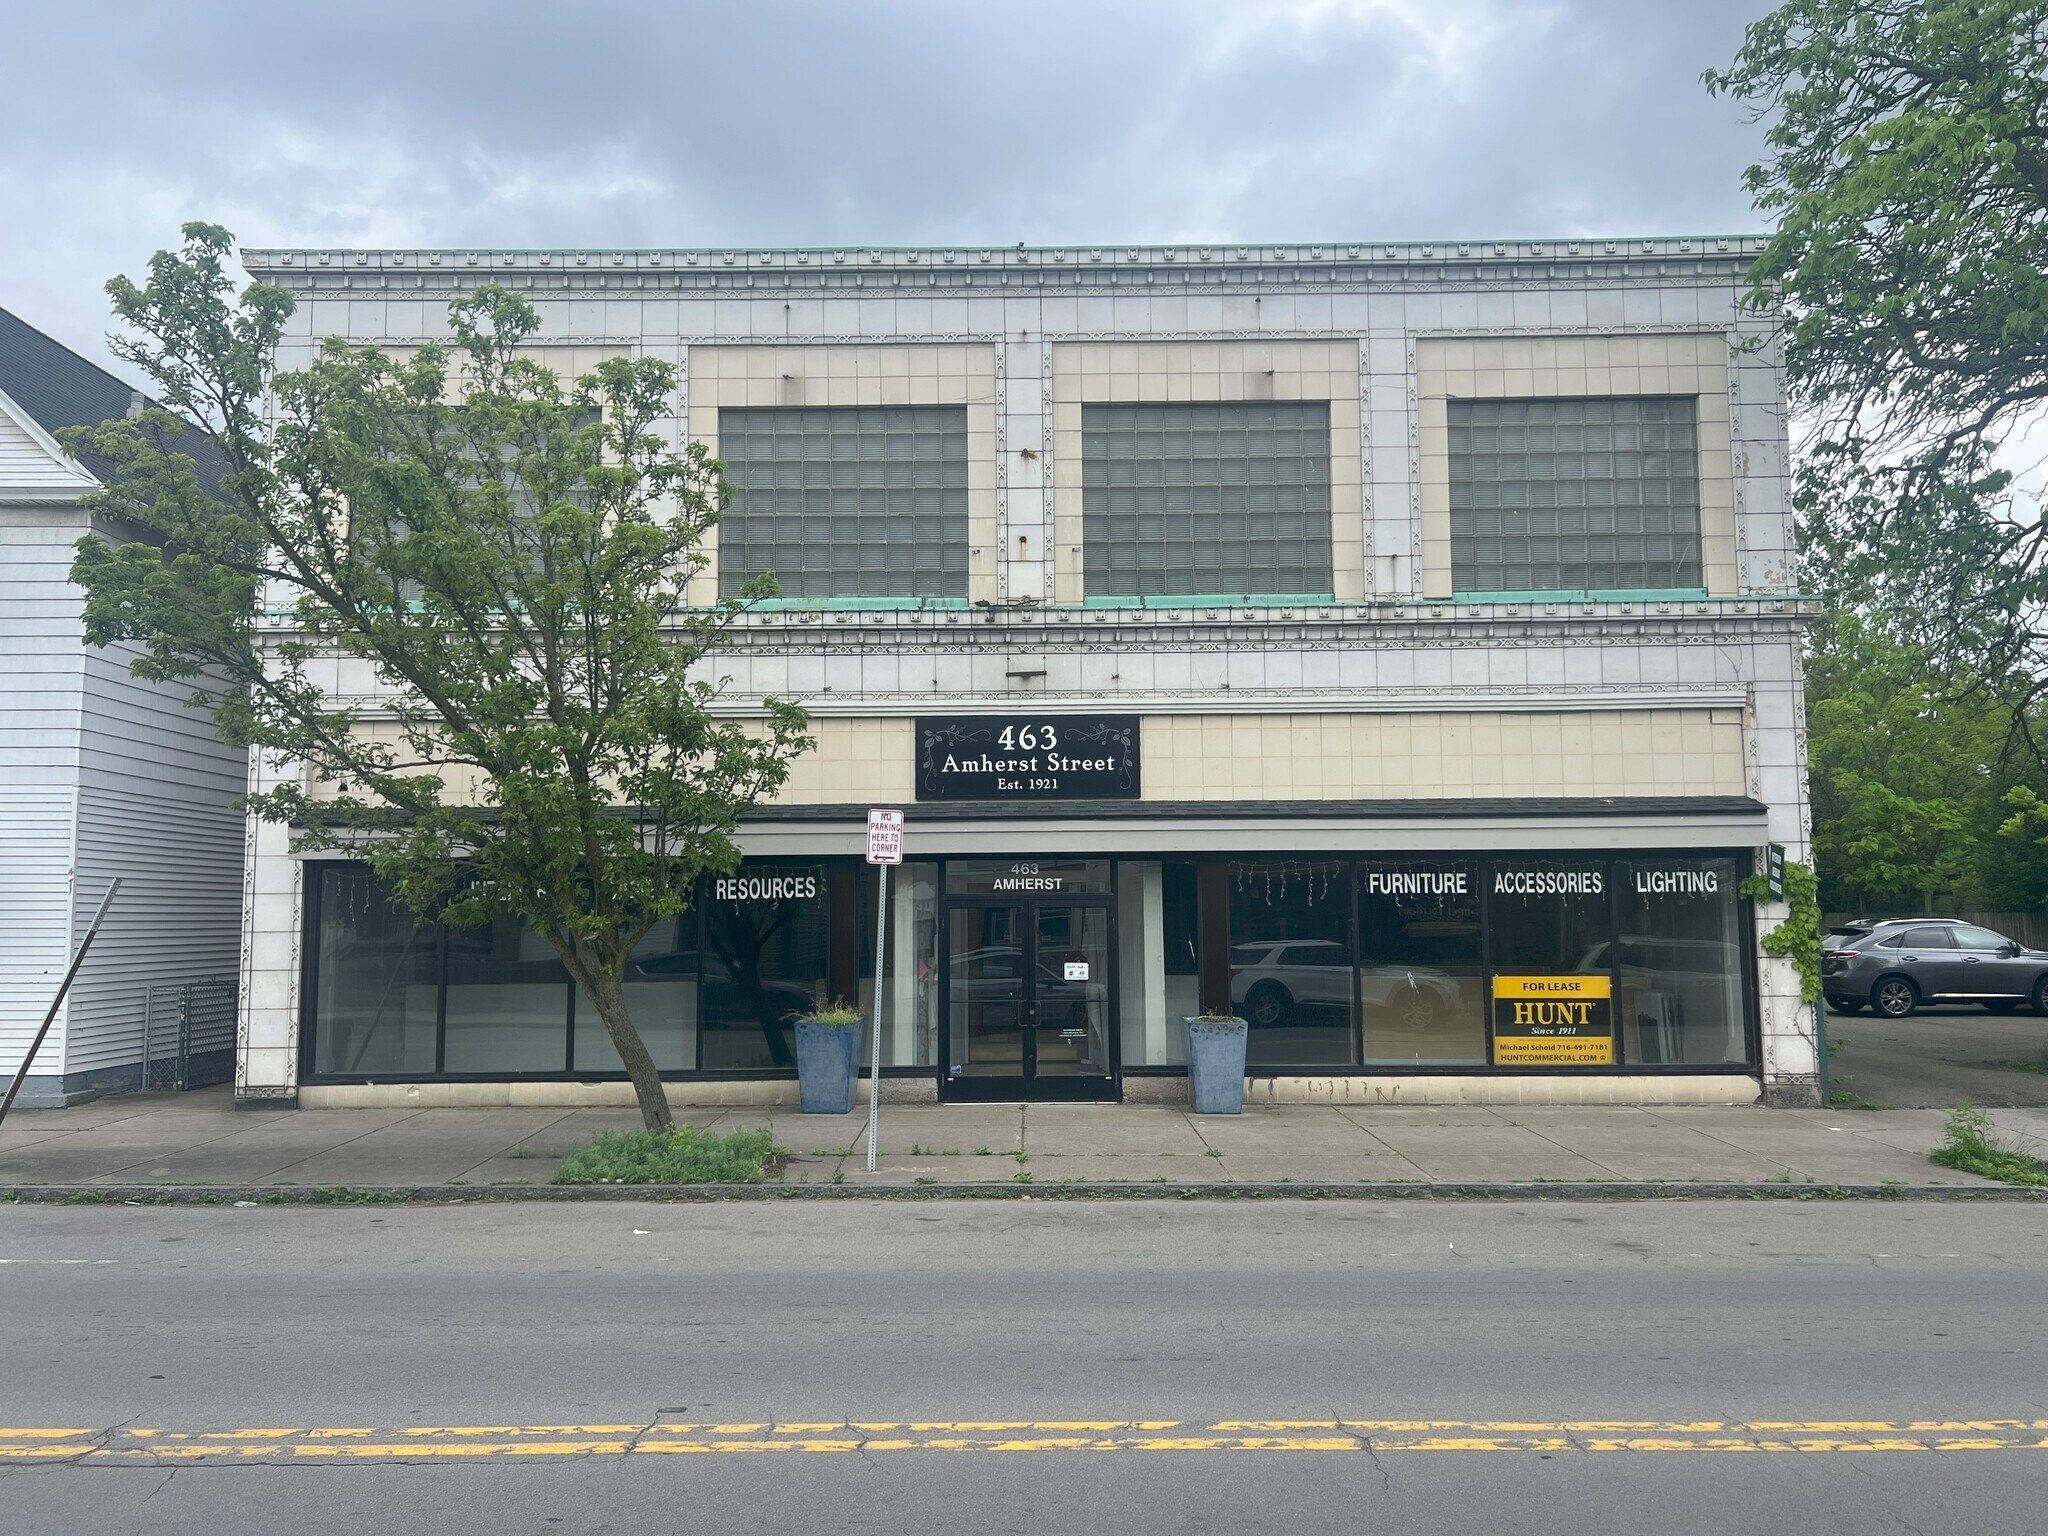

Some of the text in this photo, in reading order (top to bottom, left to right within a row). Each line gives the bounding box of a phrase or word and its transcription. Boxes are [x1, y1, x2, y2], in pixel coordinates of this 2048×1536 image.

[998, 725, 1058, 750] 463
[942, 753, 1115, 773] Amherst Street
[998, 778, 1058, 790] Est. 1921
[881, 813, 892, 821] NO
[870, 823, 901, 832] PARKING
[872, 833, 899, 842] HERE TO
[872, 843, 898, 852] CORNER
[1011, 863, 1039, 875] 463
[993, 878, 1063, 890] AMHERST
[1369, 873, 1468, 894] FURNITURE
[1495, 872, 1602, 893] ACCESSORIES
[1636, 871, 1718, 893] LIGHTING
[716, 877, 816, 900] RESOURCES
[1523, 983, 1582, 991] FOR LEASE
[1513, 1002, 1593, 1025] HUNT
[1531, 1027, 1577, 1035] Since 1911
[1500, 1054, 1597, 1062] HUNTCOMMERCIAL.COM
